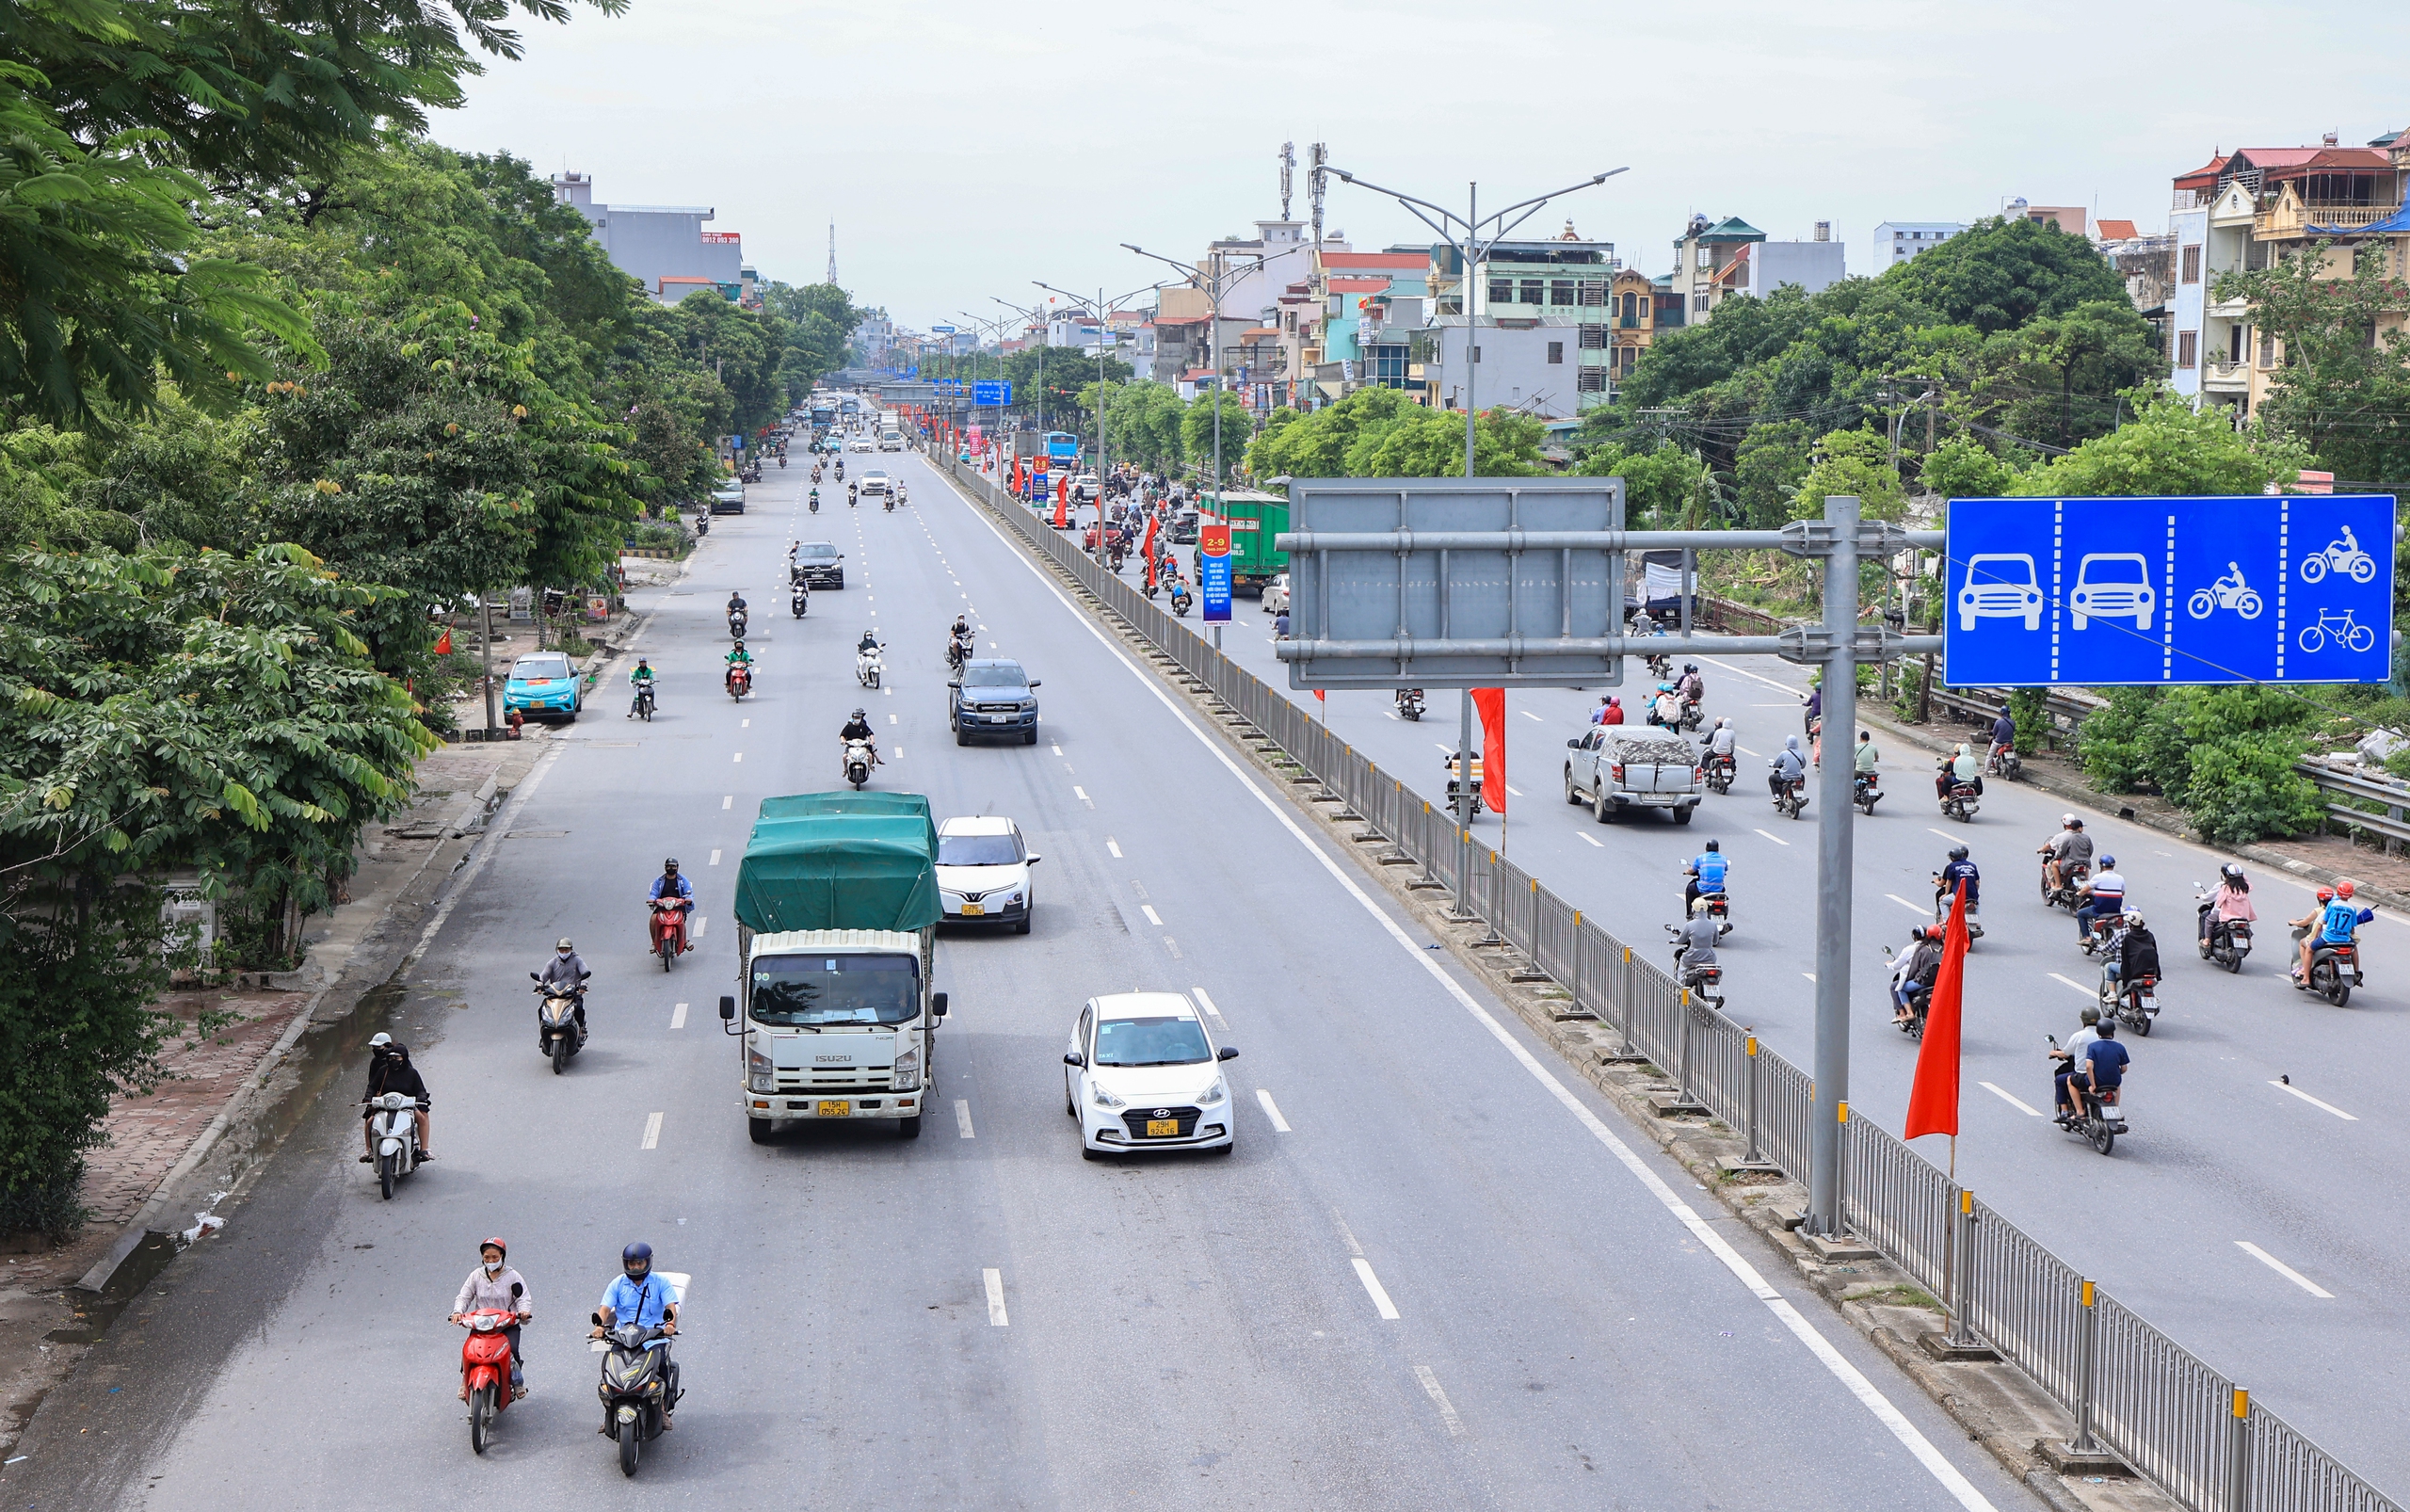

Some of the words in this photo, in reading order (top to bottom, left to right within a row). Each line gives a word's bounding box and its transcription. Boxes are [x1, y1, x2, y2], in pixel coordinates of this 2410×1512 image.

[1207, 539, 1226, 547] 2-9
[2335, 912, 2352, 930] 17
[1150, 1127, 1175, 1135] 924.16
